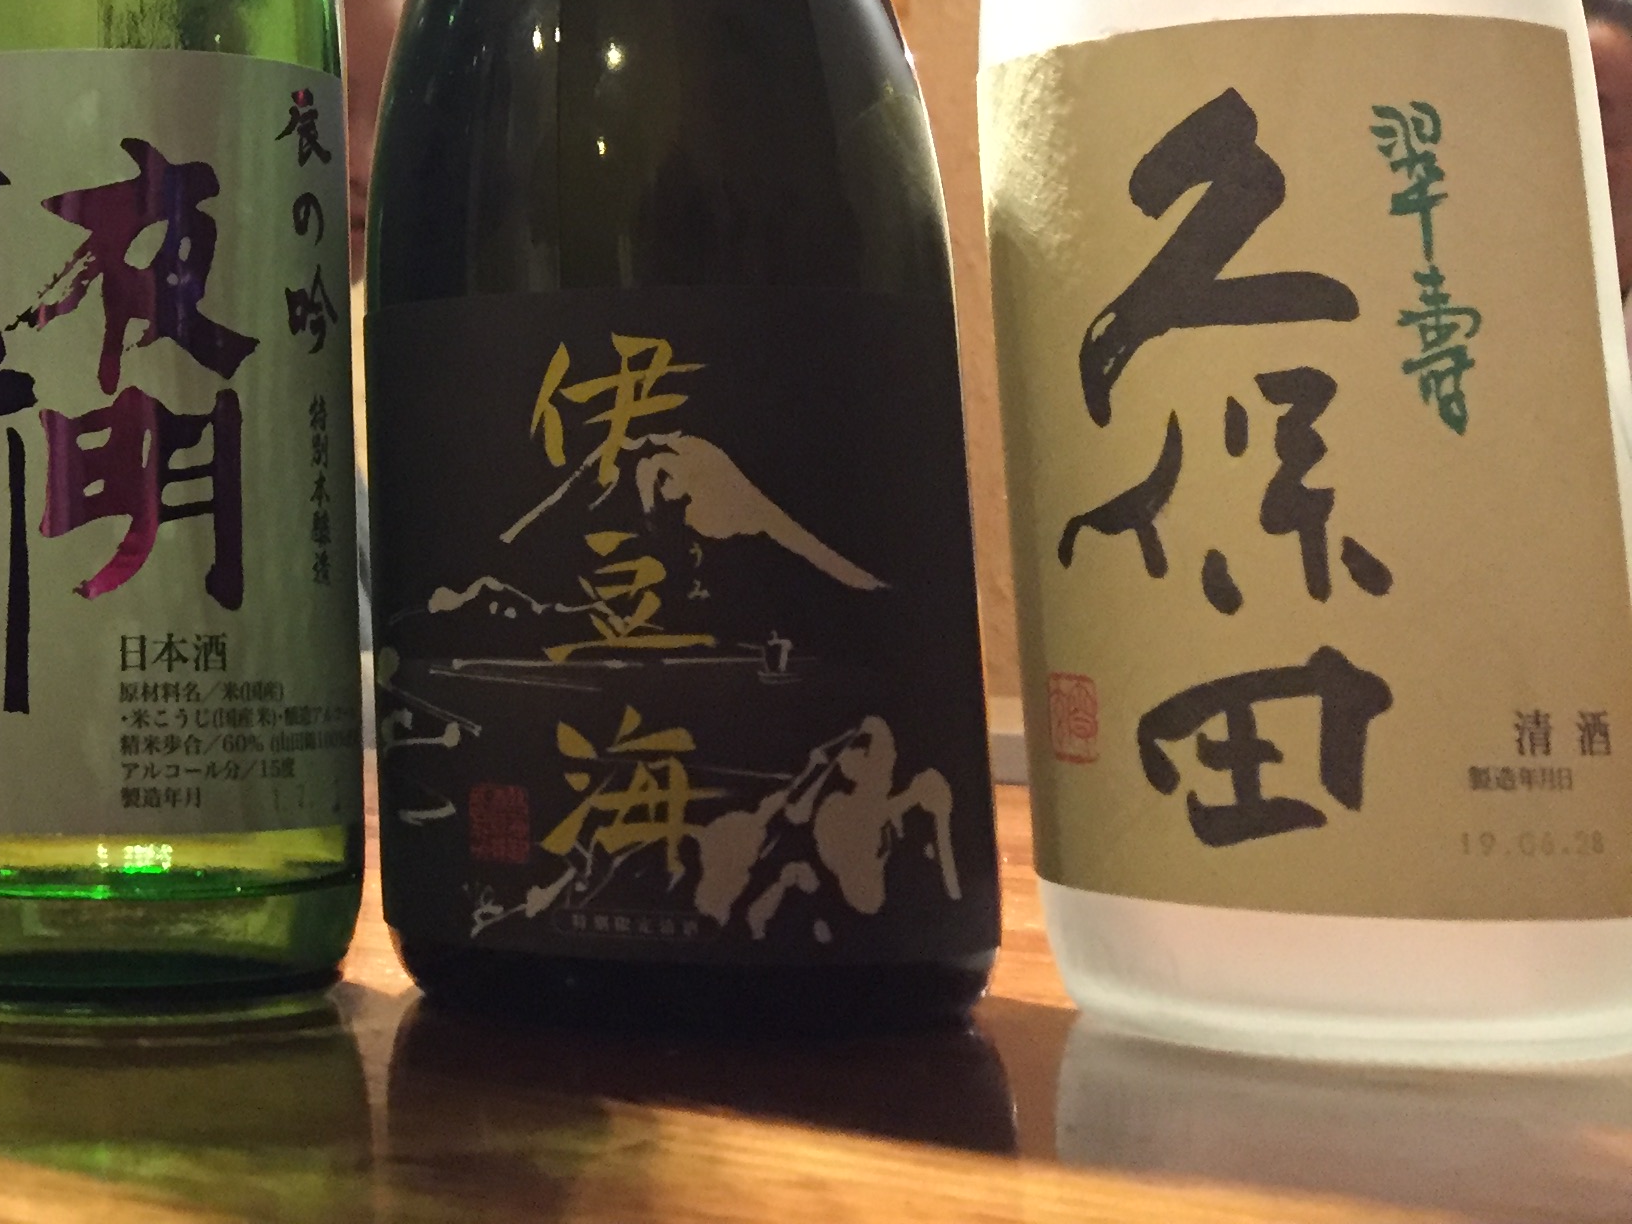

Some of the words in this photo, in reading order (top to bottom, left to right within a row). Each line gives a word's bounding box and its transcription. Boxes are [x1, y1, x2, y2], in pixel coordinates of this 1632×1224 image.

[1058, 88, 1394, 849] 久保田
[120, 633, 228, 672] 日本酒
[1514, 709, 1612, 756] 清酒
[121, 787, 201, 808] 製造年月
